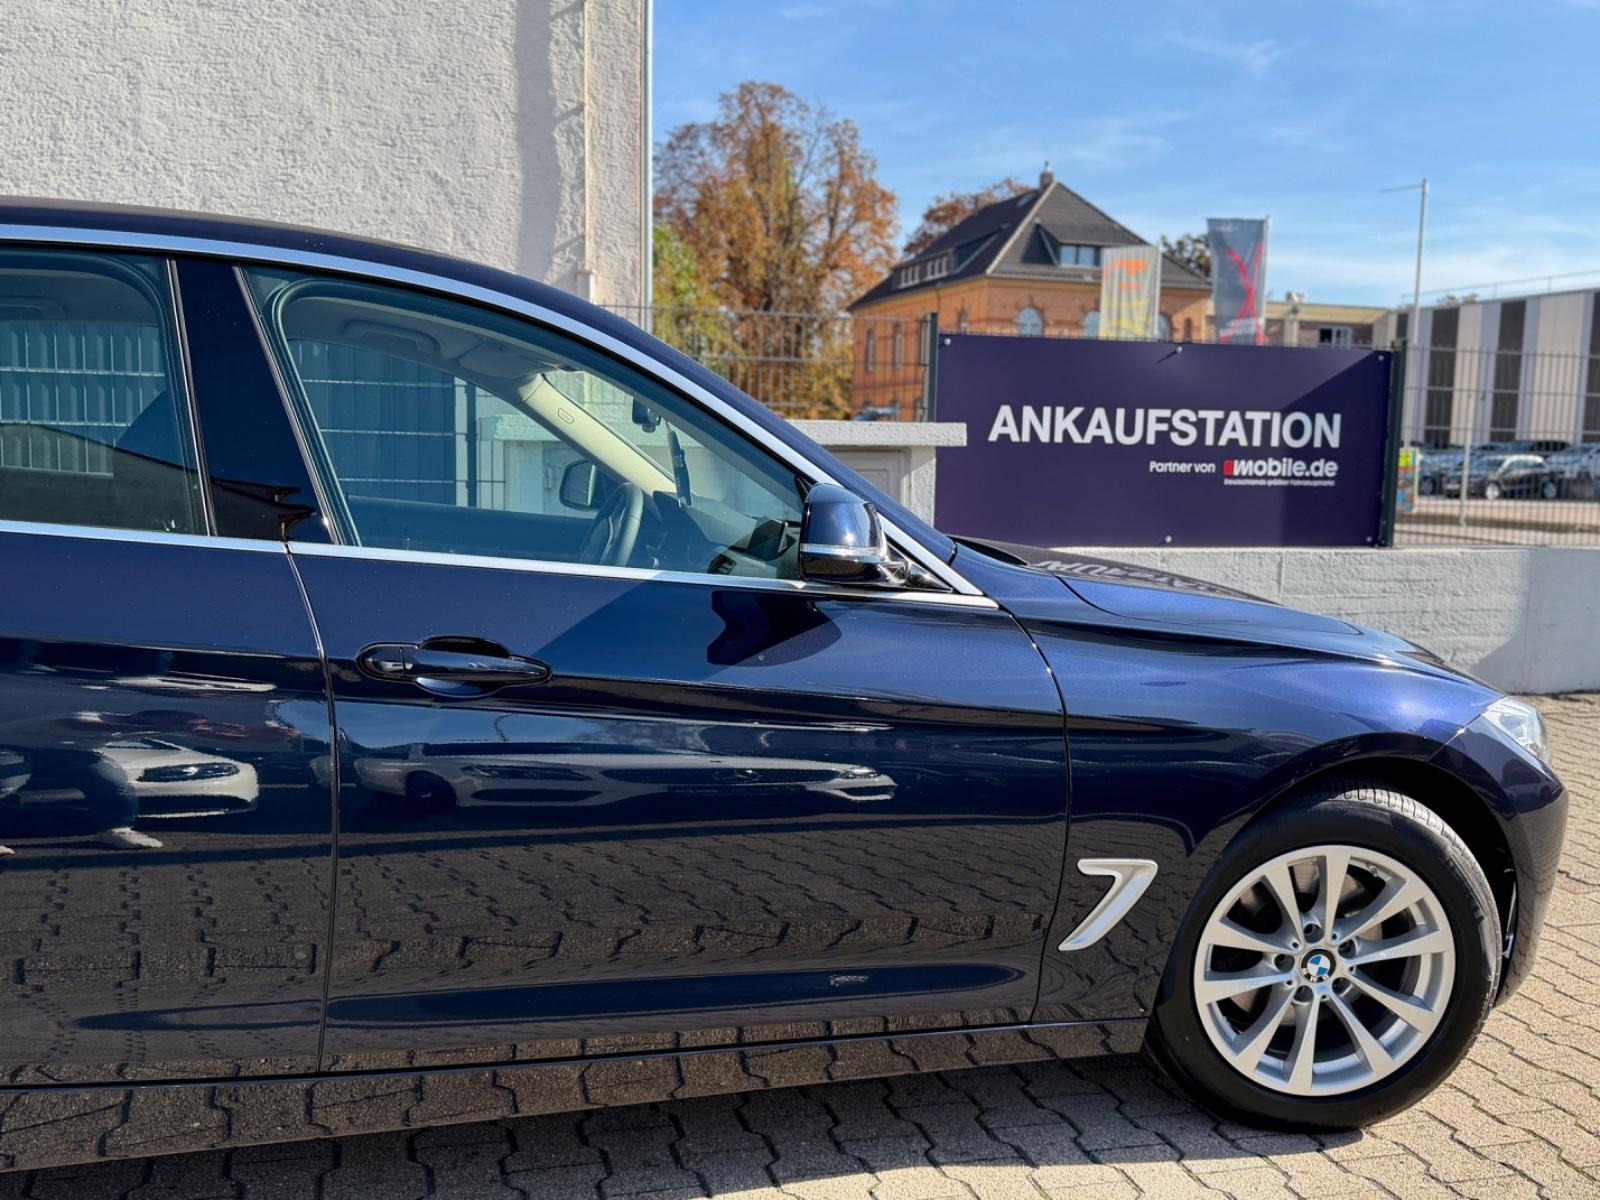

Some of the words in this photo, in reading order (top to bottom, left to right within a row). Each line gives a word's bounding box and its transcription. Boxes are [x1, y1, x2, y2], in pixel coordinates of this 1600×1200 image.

[987, 405, 1342, 448] ANKAUFSTATION
[1149, 461, 1192, 473] Partner
[1194, 464, 1216, 473] von
[1233, 458, 1338, 477] mobile.de
